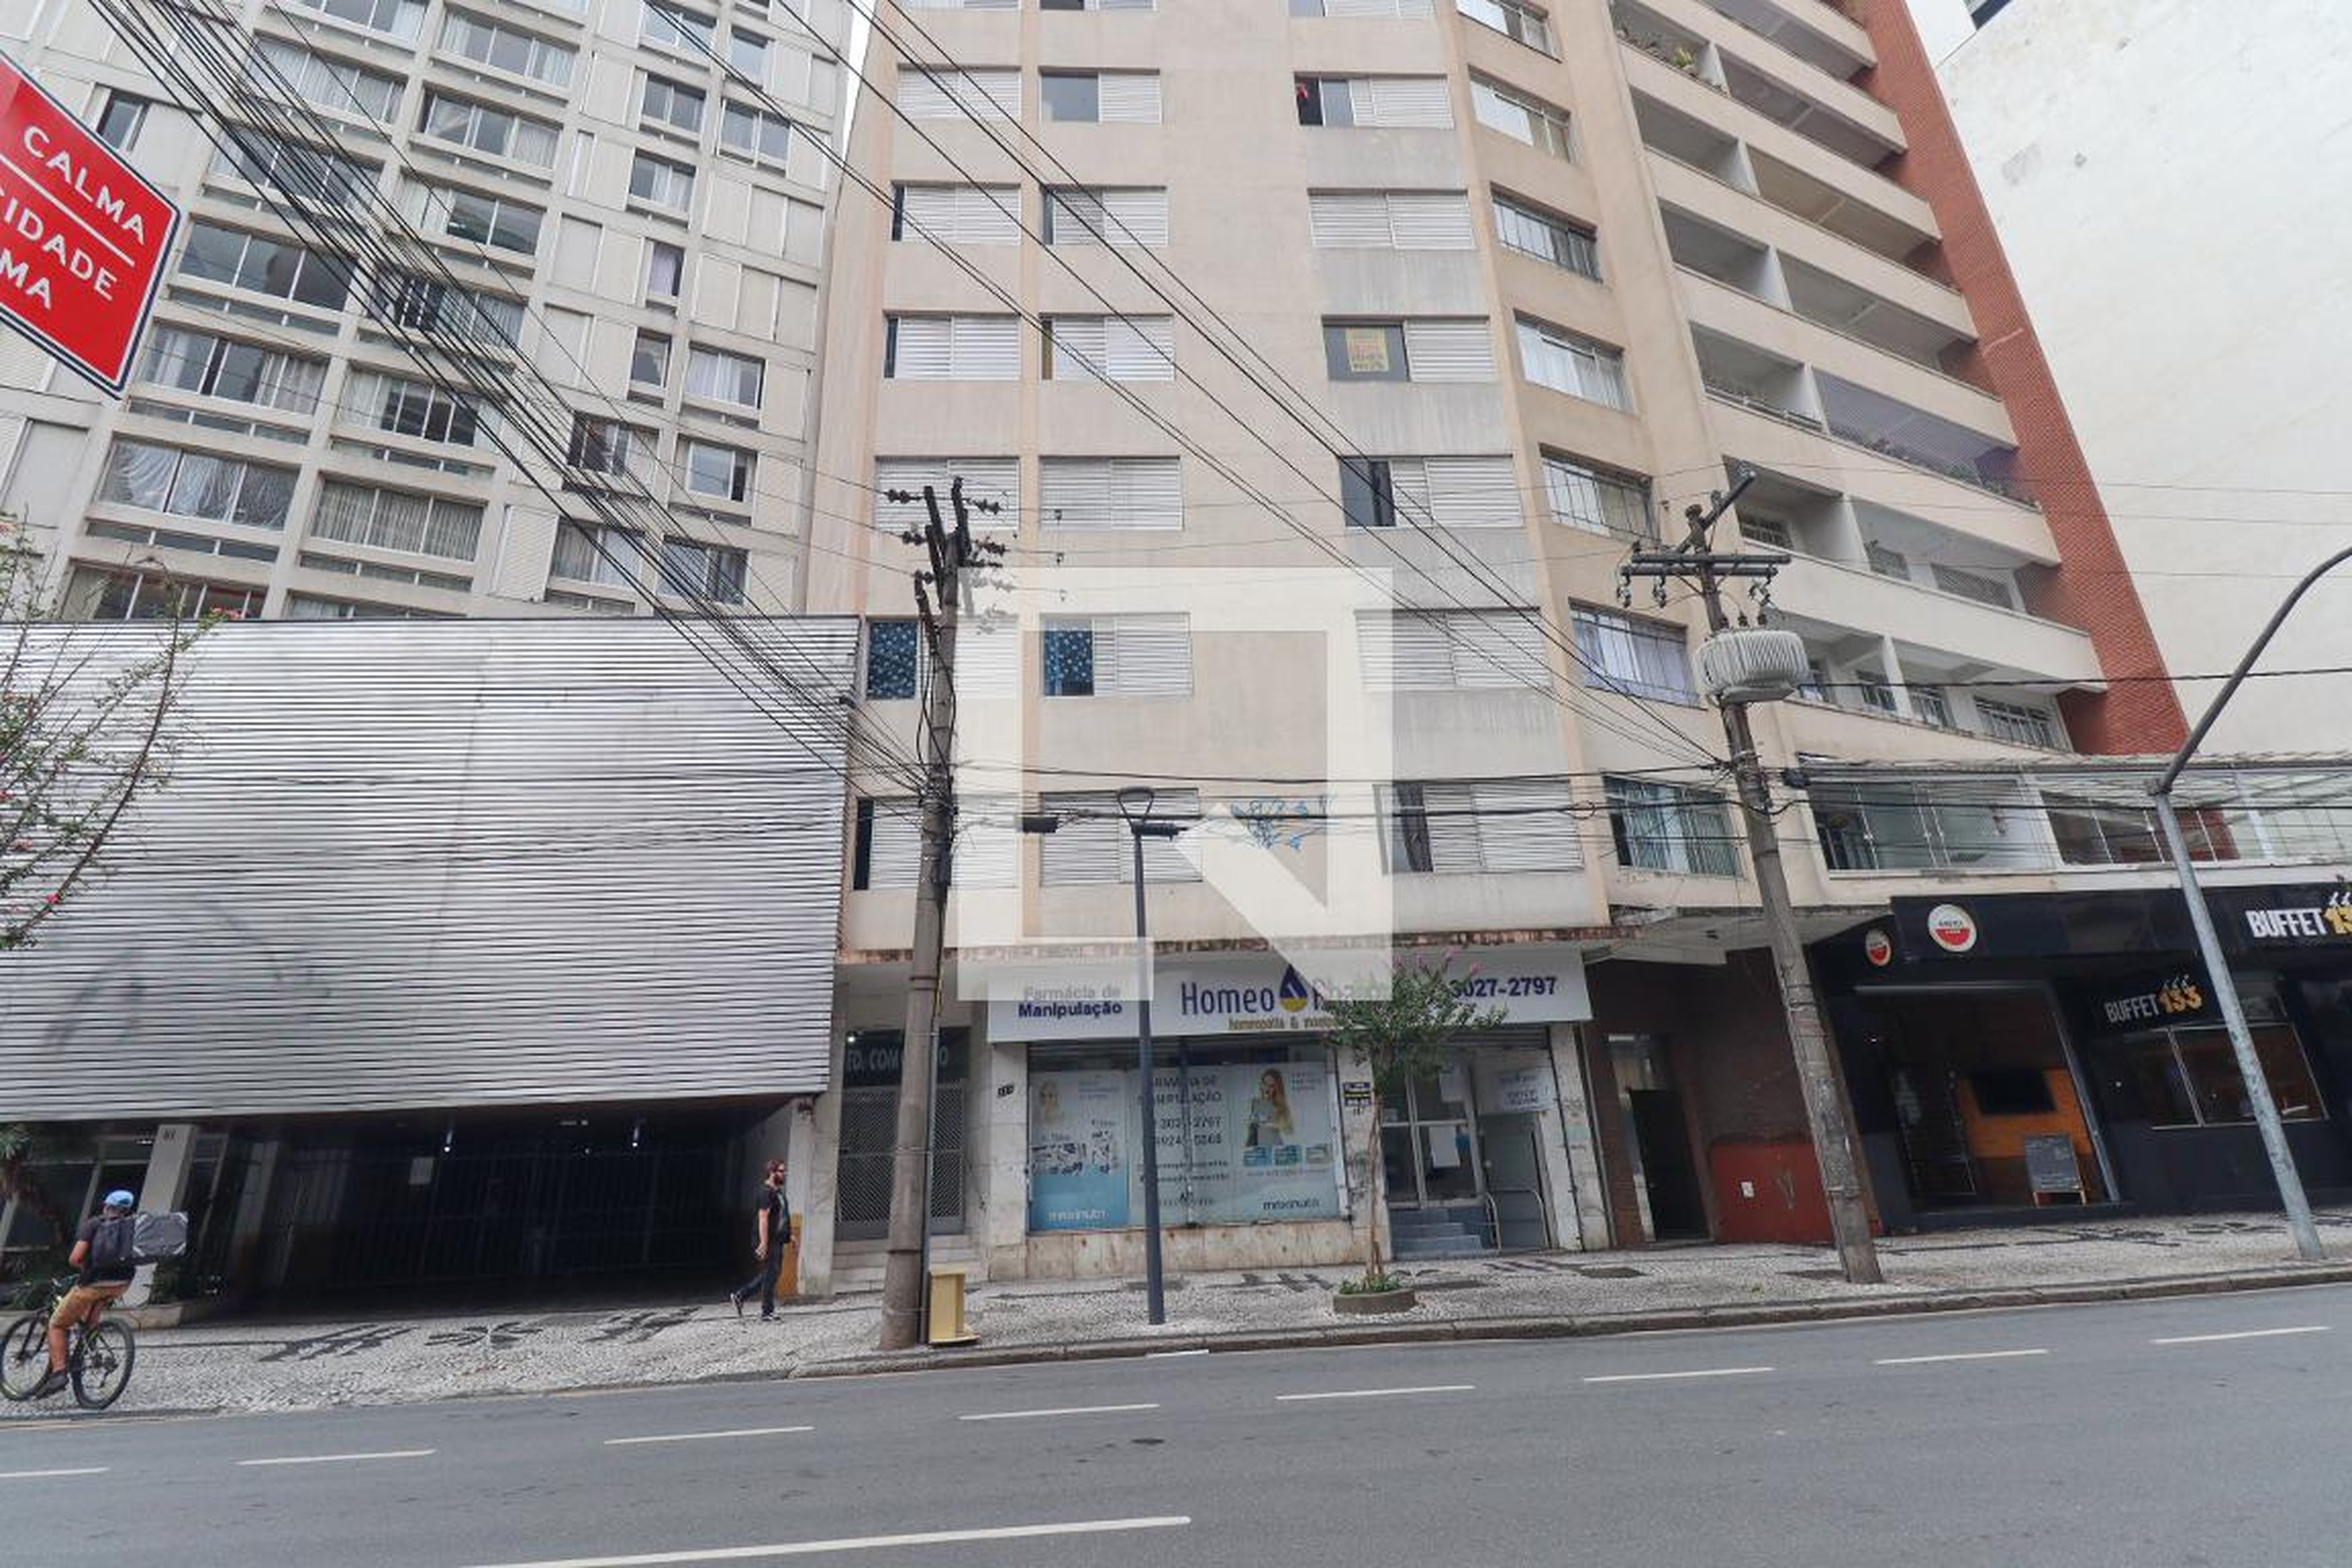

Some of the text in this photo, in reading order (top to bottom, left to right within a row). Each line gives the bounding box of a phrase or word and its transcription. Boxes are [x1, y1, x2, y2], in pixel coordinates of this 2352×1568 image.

[23, 126, 145, 244] CALMA
[0, 186, 118, 301] IDADE
[2245, 907, 2327, 938] BUFFET
[1018, 1001, 1123, 1020] Manipulação
[1182, 982, 1275, 1015] Homeo
[2104, 993, 2159, 1023] BUFFET
